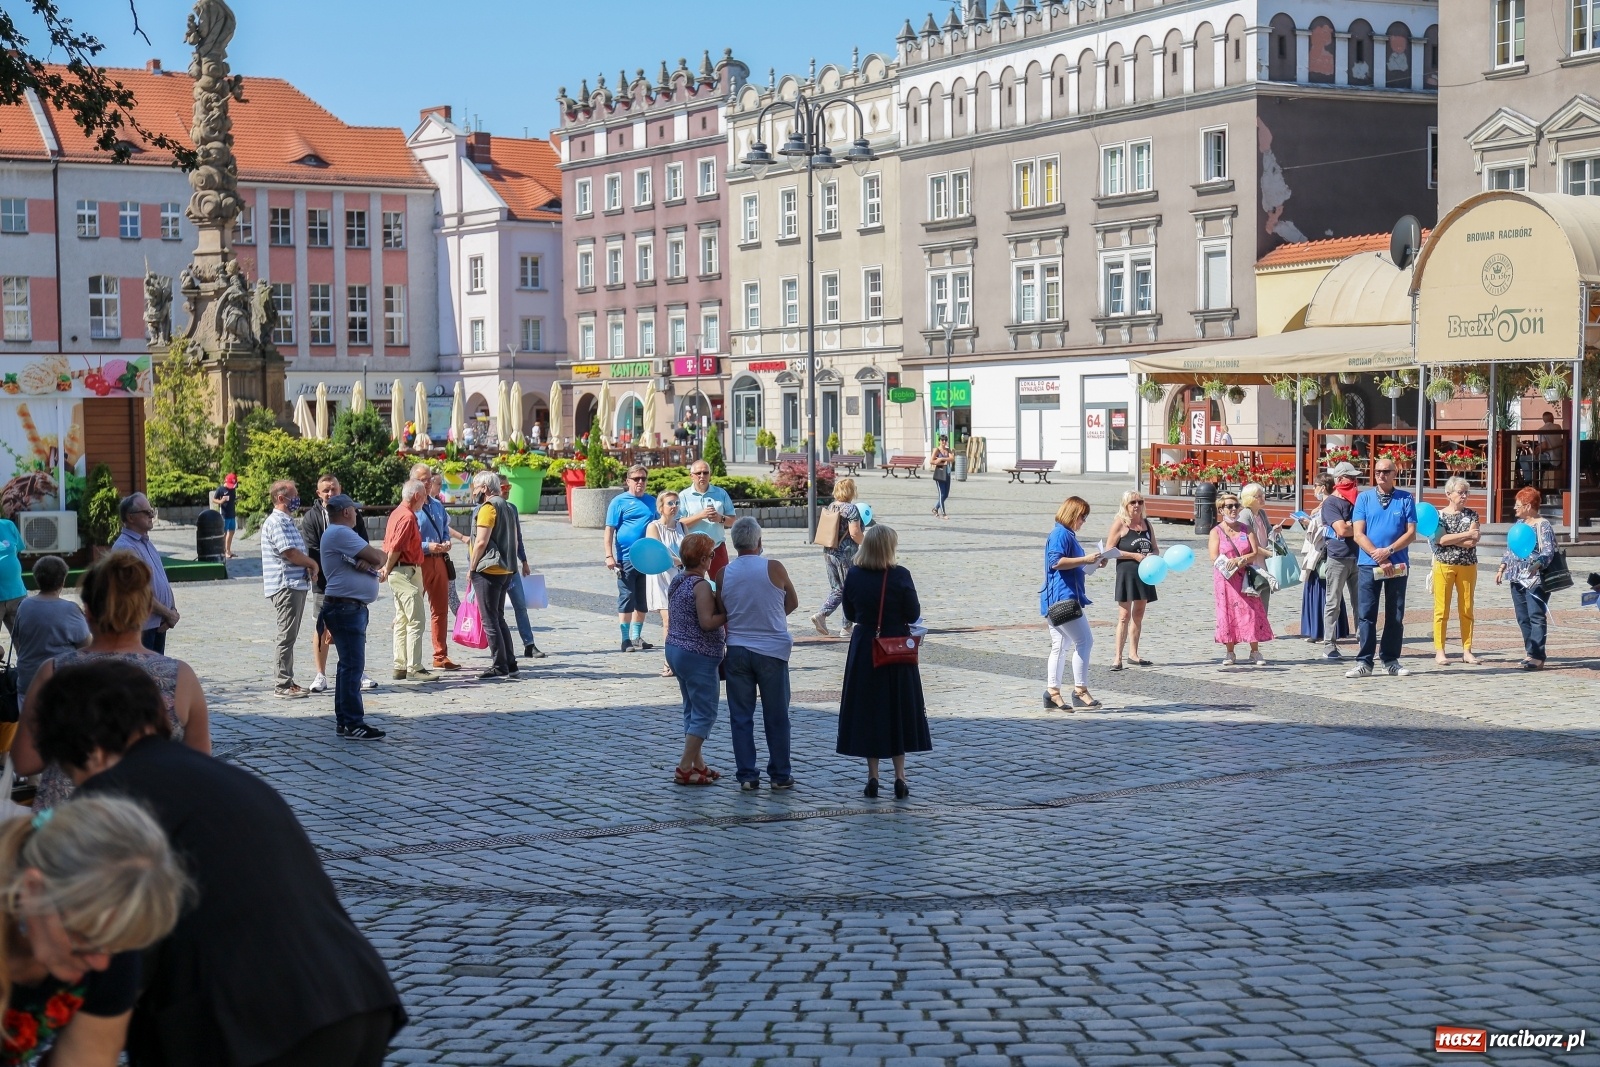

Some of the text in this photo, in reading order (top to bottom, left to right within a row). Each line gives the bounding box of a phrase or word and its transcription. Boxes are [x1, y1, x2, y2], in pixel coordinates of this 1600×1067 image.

[1466, 226, 1533, 242] BROWAR RACIBÓRZ
[796, 357, 822, 371] SHIO
[1348, 356, 1412, 366] BROWAR RACIBÓR
[610, 362, 651, 377] KANTOR
[894, 389, 915, 398] żabka
